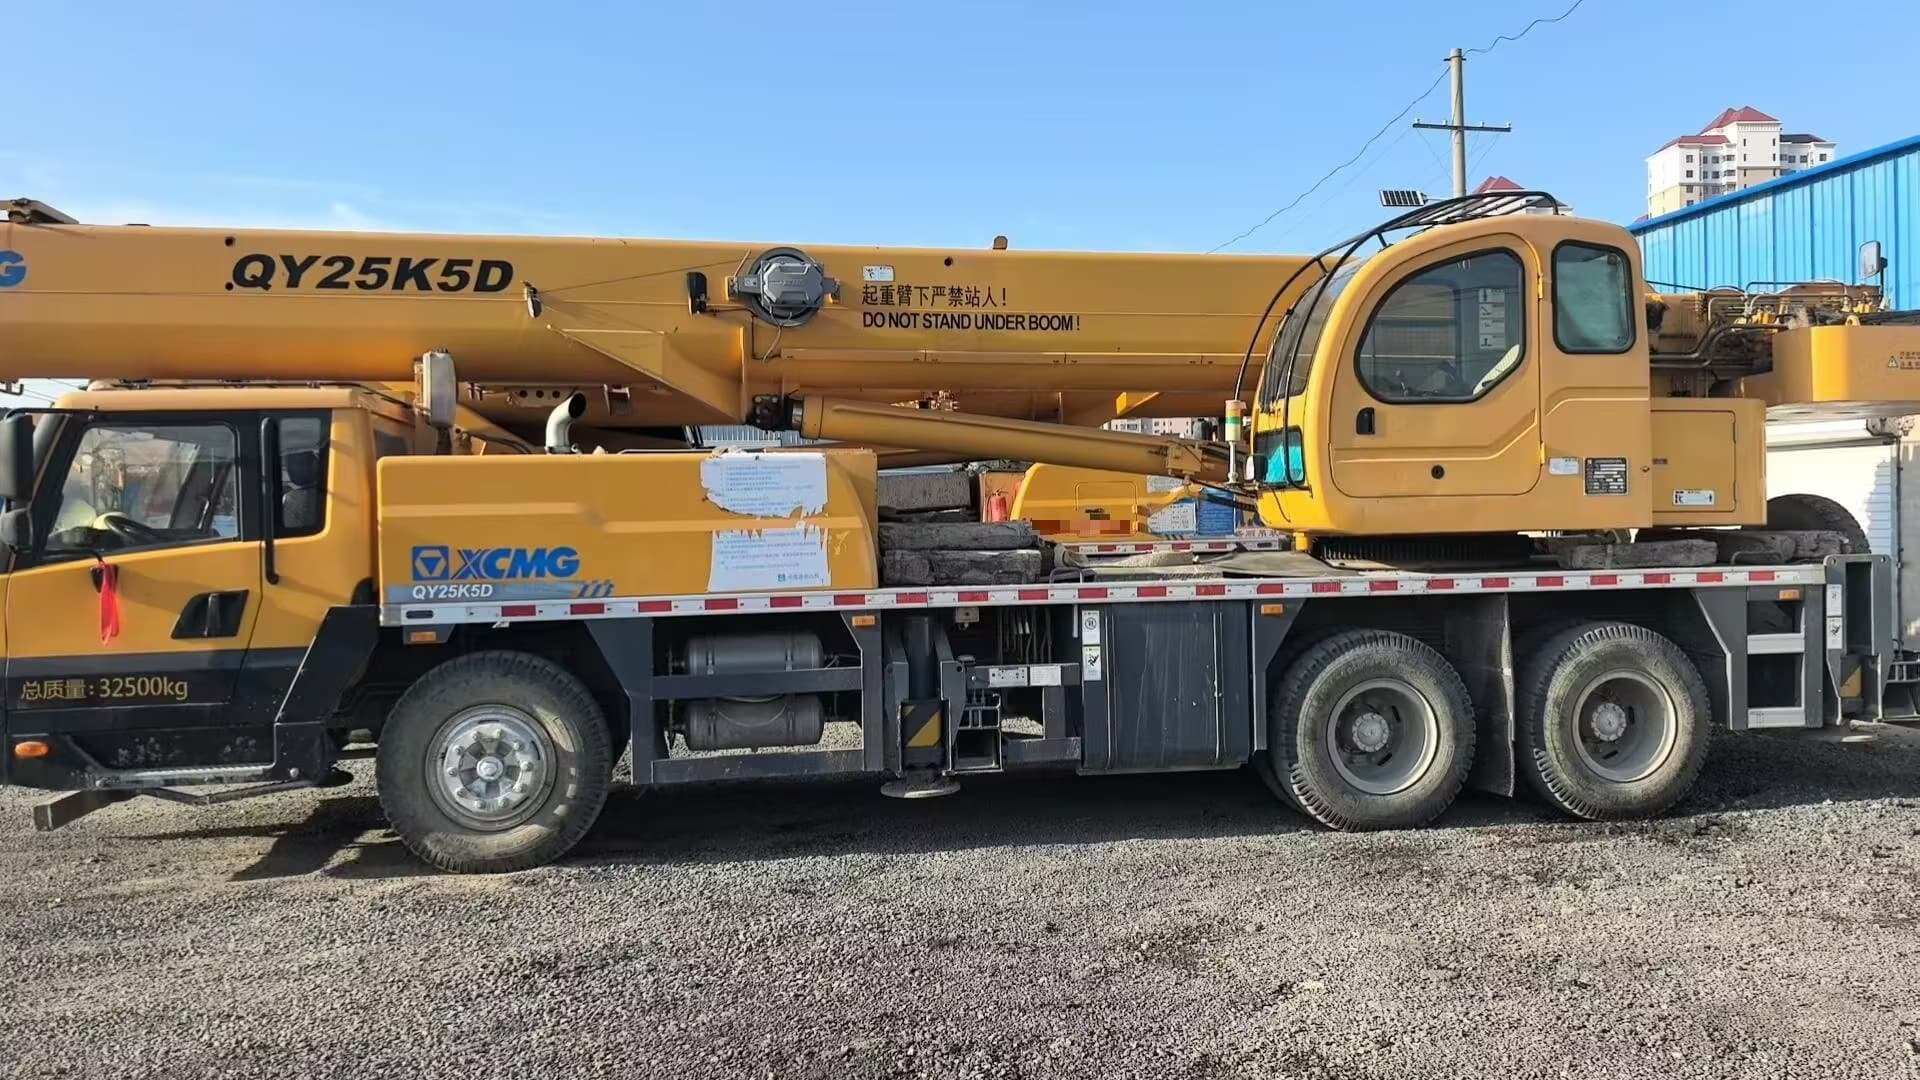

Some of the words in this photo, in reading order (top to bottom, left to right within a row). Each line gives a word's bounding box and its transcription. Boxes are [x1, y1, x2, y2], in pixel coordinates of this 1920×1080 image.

[232, 253, 514, 292] QY25K5D
[862, 283, 1007, 307] 起重臂下严禁站人！
[863, 311, 885, 328] DO
[888, 312, 919, 328] NOT
[922, 313, 971, 329] STAND
[974, 314, 1026, 330] UNDER
[450, 547, 580, 580] XCMG
[412, 583, 493, 600] QY25K5D
